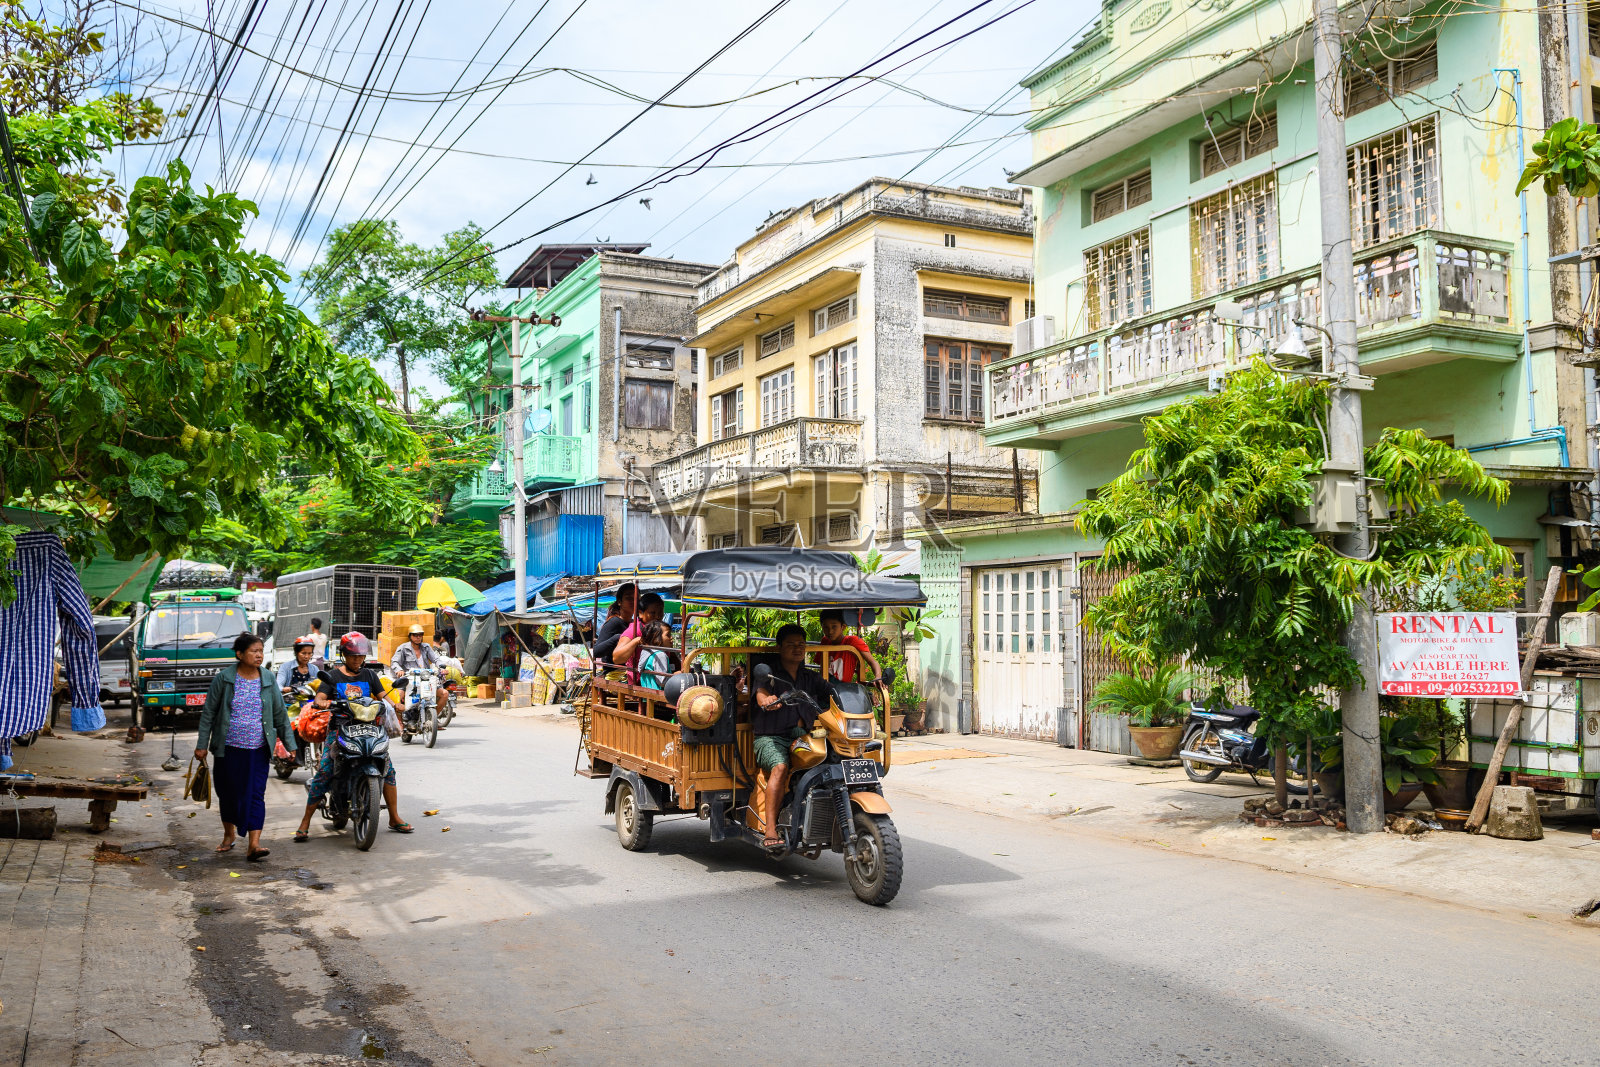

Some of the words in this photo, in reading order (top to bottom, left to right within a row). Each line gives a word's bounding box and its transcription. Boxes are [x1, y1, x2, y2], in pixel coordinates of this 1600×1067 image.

[1391, 615, 1504, 634] RENTAL
[1389, 661, 1465, 671] AVAIABLE
[1469, 661, 1510, 671] HERE
[176, 667, 220, 677] TOYOTA
[1441, 672, 1457, 680] Bet
[1460, 672, 1489, 680] 26x27
[1386, 682, 1413, 693] Call
[1427, 682, 1514, 694] 09-402532219
